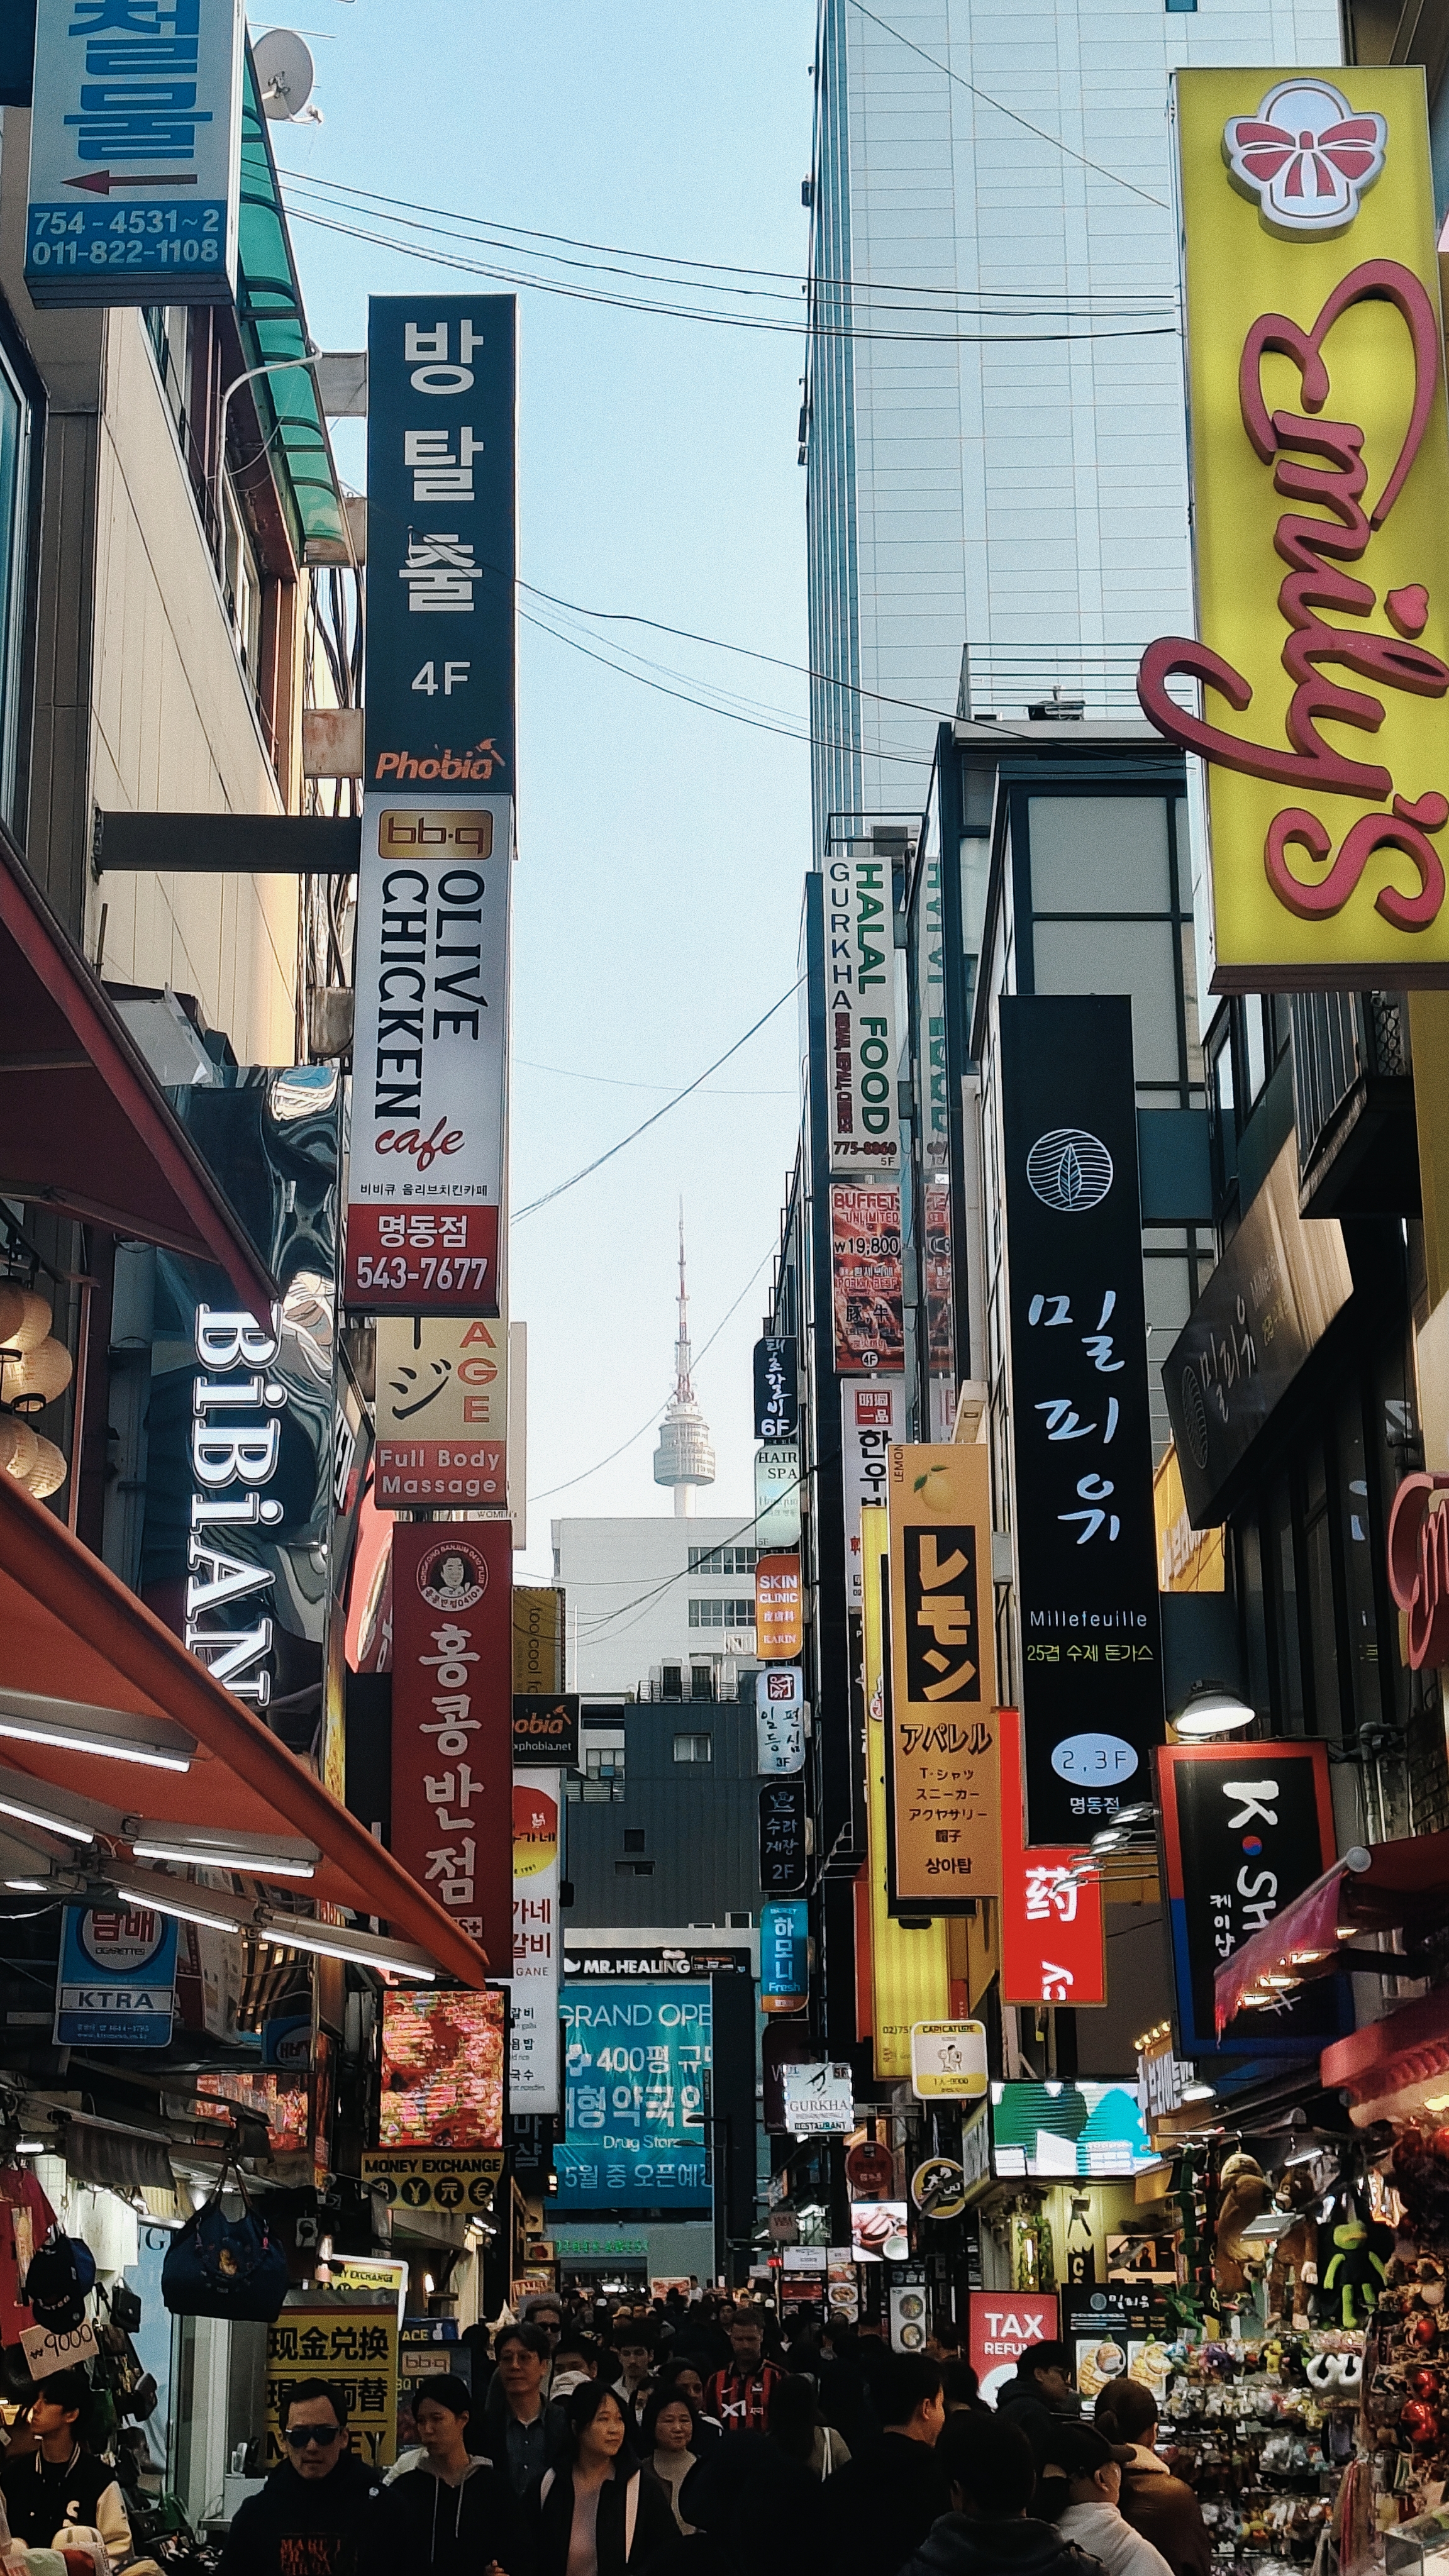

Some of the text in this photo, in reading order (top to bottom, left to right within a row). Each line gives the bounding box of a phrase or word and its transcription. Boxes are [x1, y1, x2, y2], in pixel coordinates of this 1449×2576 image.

[33, 239, 218, 265] 011-822-1108
[411, 661, 470, 696] 4F
[375, 750, 492, 780] Phobia
[830, 862, 852, 1009] GURKHA
[433, 869, 488, 1040] OLIVE
[375, 869, 429, 1119] CHICKEN
[856, 863, 889, 1135] HALAL FOOD
[375, 1116, 465, 1171] cafe
[881, 1157, 894, 1166] 5F
[360, 1184, 396, 1196] 비비큐
[378, 1214, 468, 1248] 명동점
[357, 1257, 488, 1290] 543-7677
[863, 1355, 876, 1366] 4F
[761, 1419, 790, 1436] 6F
[380, 1450, 500, 1471] Full Body
[758, 1452, 797, 1463] HAIR
[894, 1445, 904, 1482] LEMON
[768, 1468, 797, 1479] SPA
[382, 1477, 497, 1497] Massage
[760, 1575, 797, 1589] SKIN
[760, 1592, 799, 1603] CLINIC
[917, 1535, 977, 1701] レモン
[1030, 1611, 1147, 1628] Millefeuille
[528, 1639, 541, 1674] cool
[1067, 1645, 1098, 1662] 수제
[1105, 1645, 1154, 1662] 돈가스
[900, 1723, 993, 1755] アパレル
[418, 1623, 484, 1906] 홍콩반점
[772, 1864, 794, 1879] 2F
[926, 1857, 972, 1875] 상아탑
[583, 1960, 691, 1974] MR.HEALING
[769, 1982, 801, 1992] Fresh
[79, 1992, 153, 2009] KTRA
[597, 2046, 670, 2074] 400평
[790, 2100, 850, 2112] GURKHA
[603, 2135, 640, 2151] Drug
[365, 2159, 501, 2174] MONEY EXCHANGE
[565, 2165, 597, 2189] 5월
[607, 2165, 626, 2188] 중
[984, 2312, 1044, 2339] TAX
[270, 2326, 389, 2360] 现金兑换
